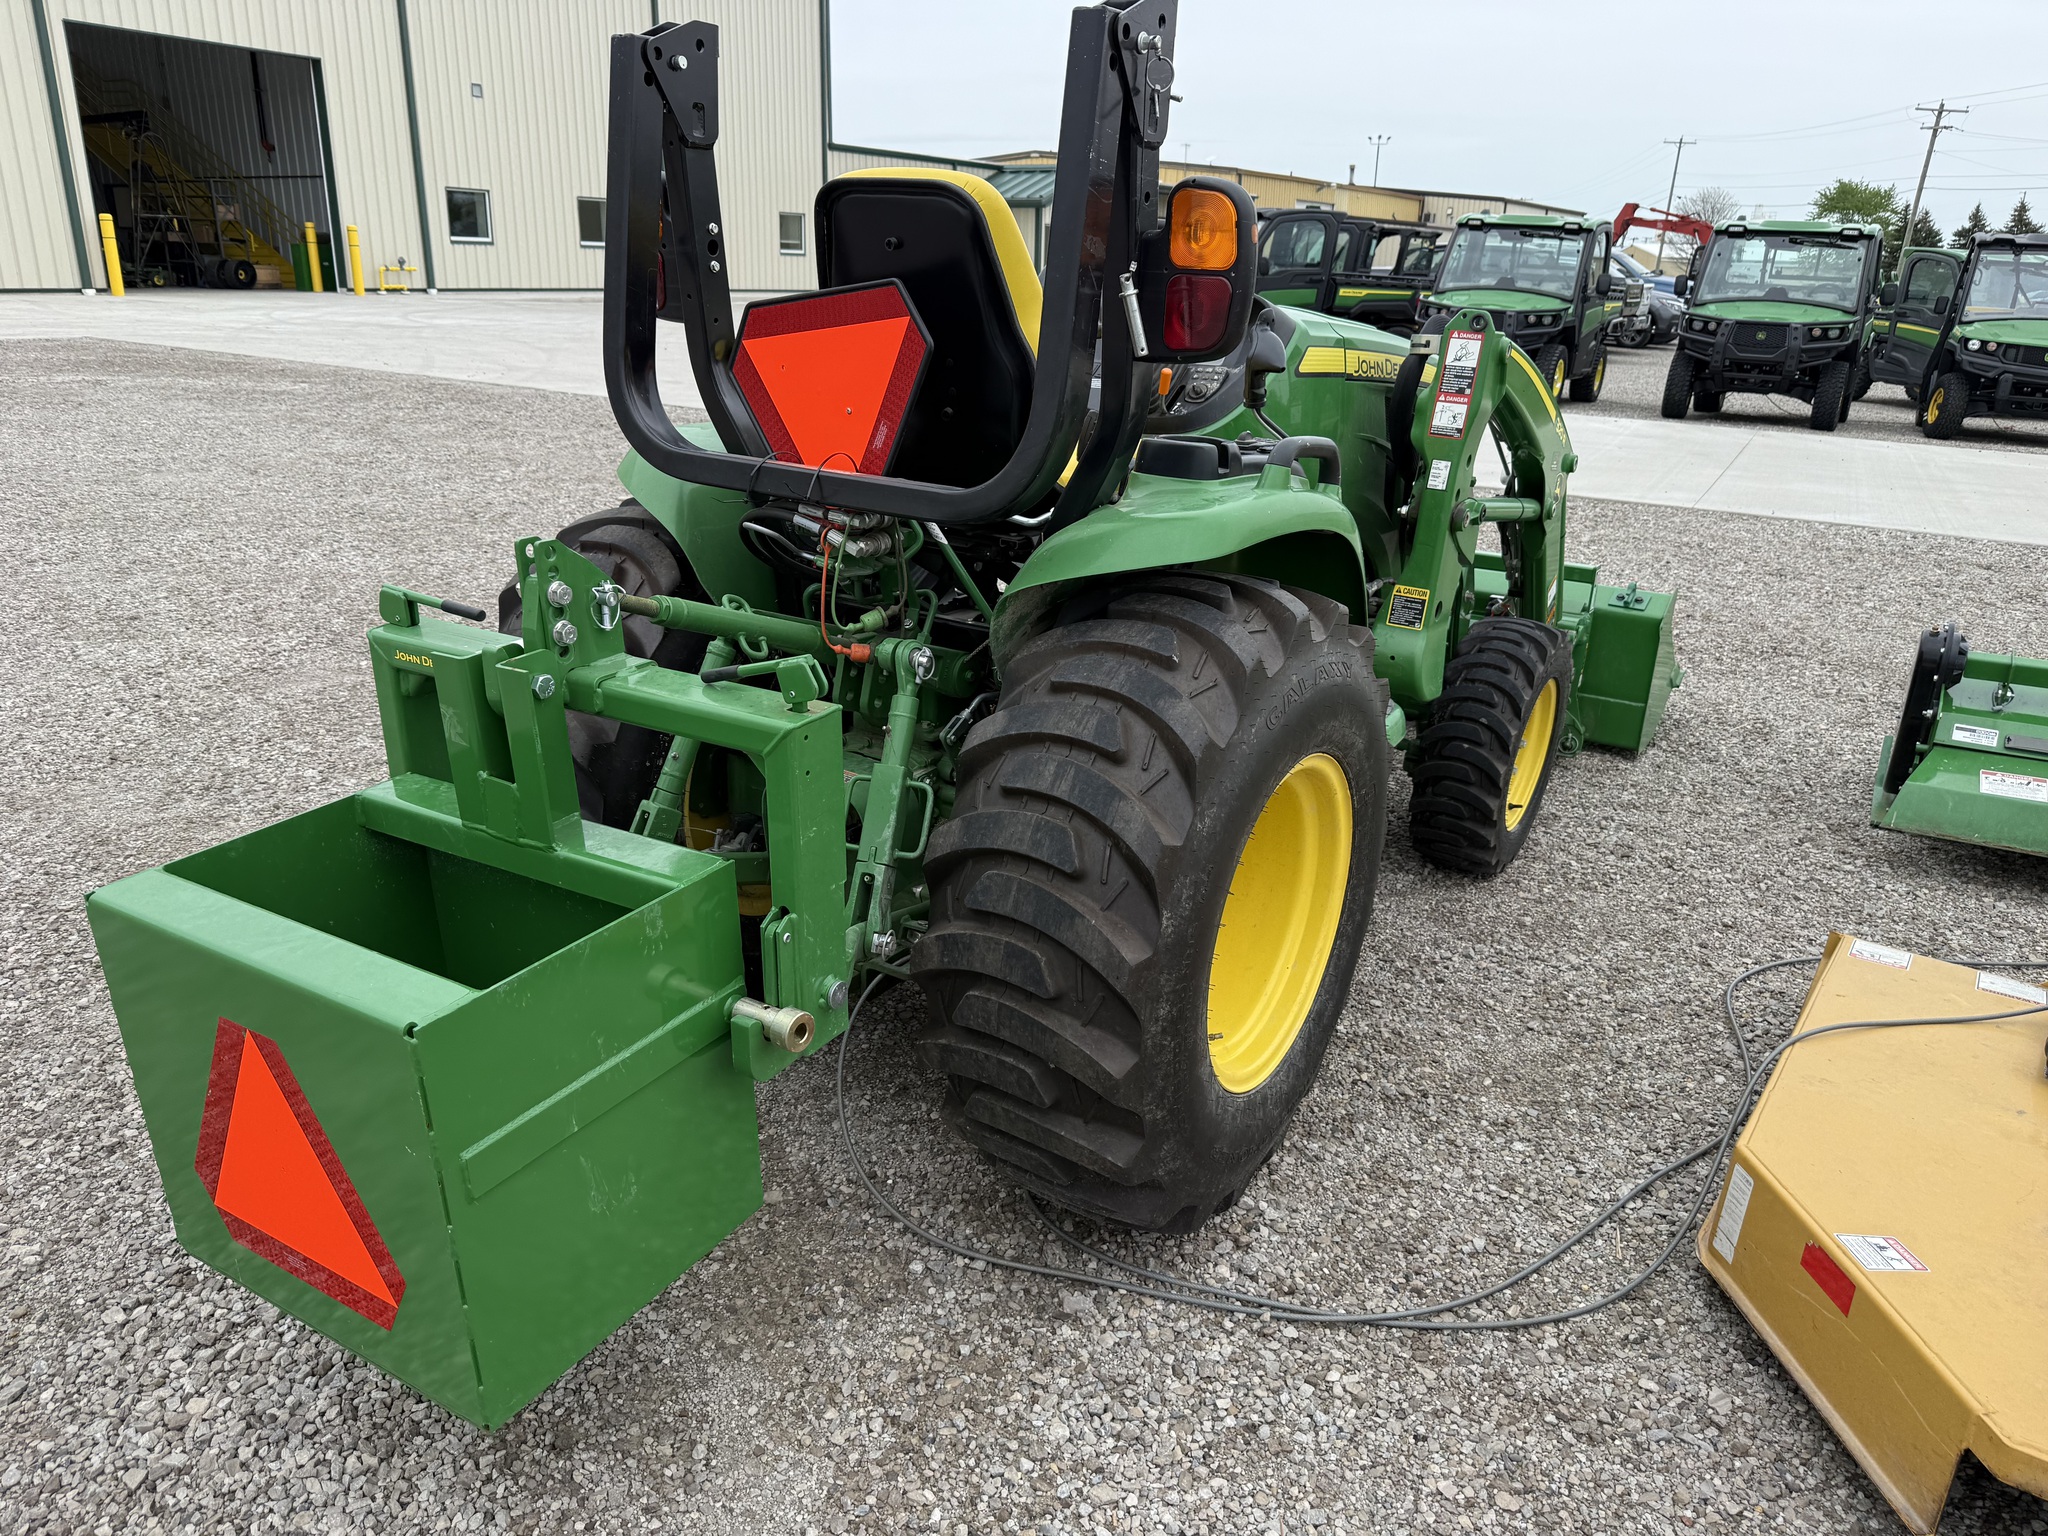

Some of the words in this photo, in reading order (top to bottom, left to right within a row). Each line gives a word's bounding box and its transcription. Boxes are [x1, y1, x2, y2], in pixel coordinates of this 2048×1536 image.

[1459, 332, 1482, 340] DANGER
[1354, 355, 1384, 376] JOHN
[1385, 358, 1400, 377] DE
[1402, 587, 1428, 598] CAUTION
[394, 649, 421, 665] JOHN
[1265, 661, 1352, 730] GALAXY
